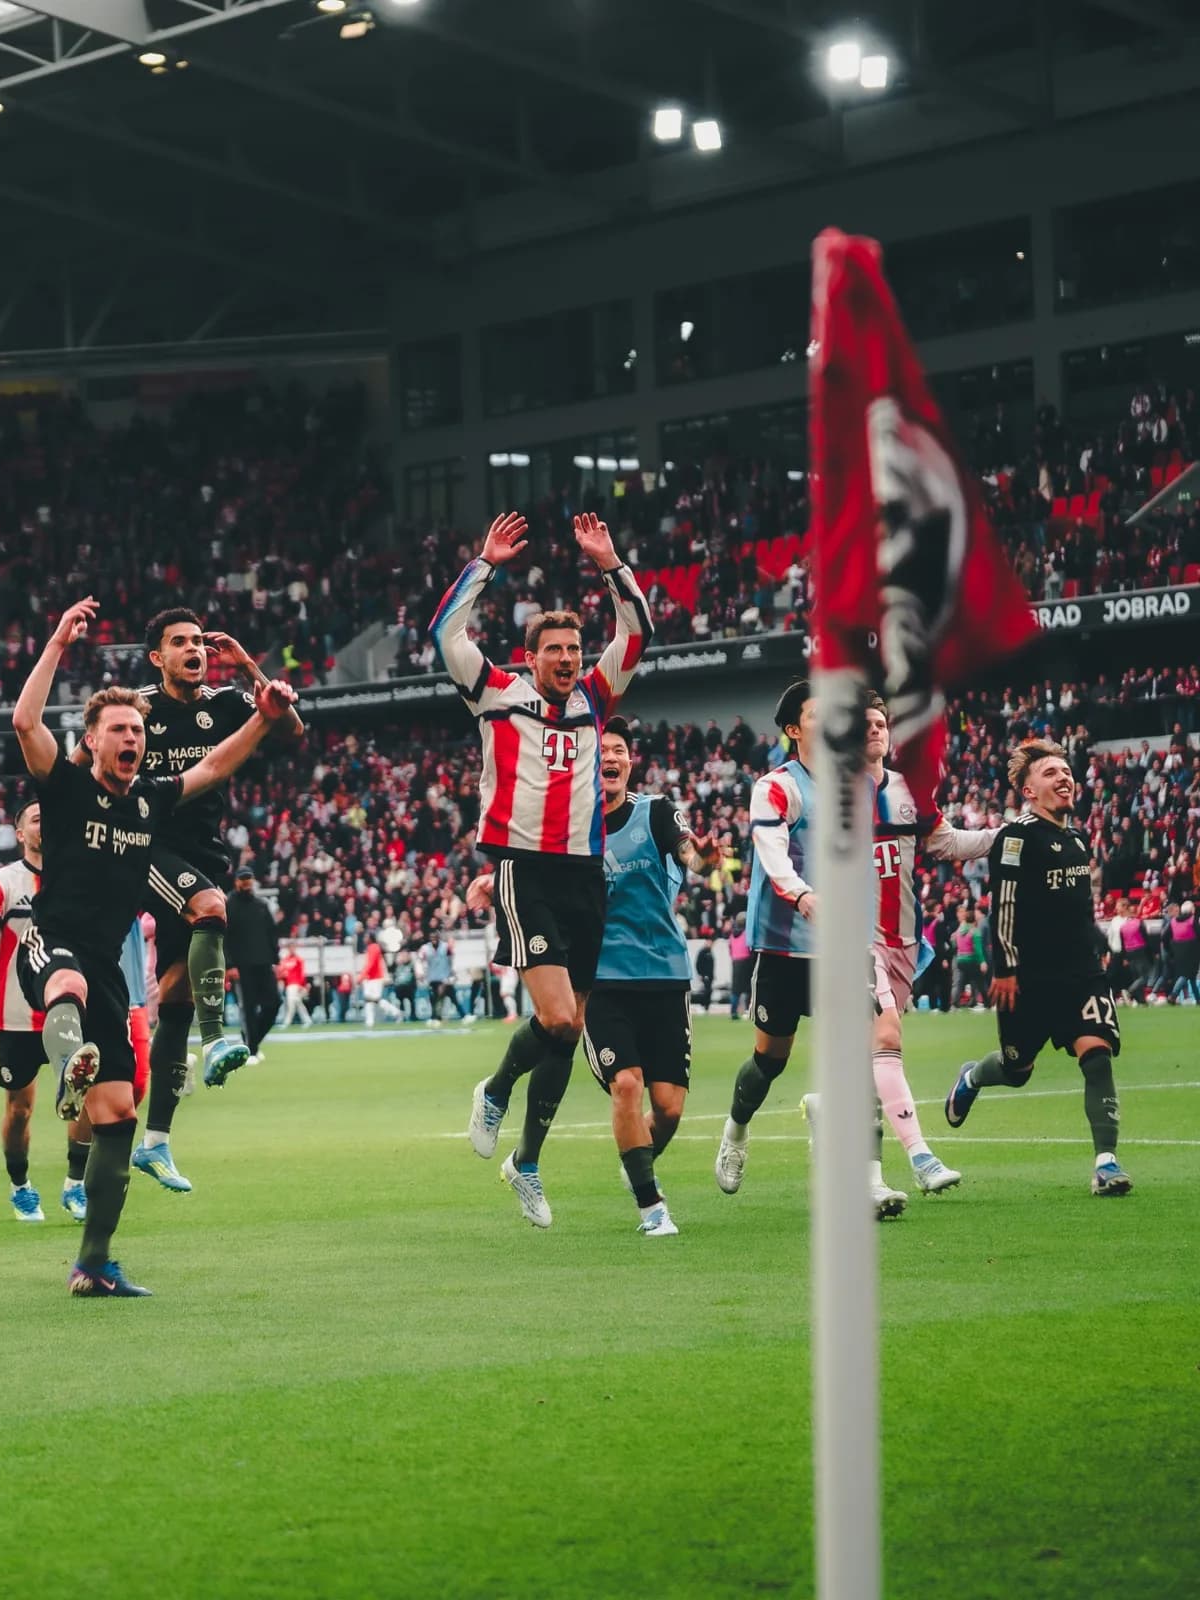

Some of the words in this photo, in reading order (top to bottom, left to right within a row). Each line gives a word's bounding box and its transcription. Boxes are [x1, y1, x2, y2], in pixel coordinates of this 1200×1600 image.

[1103, 591, 1191, 623] JOBRAD
[168, 760, 185, 771] TV
[112, 840, 126, 855] TV
[1081, 995, 1116, 1026] 42
